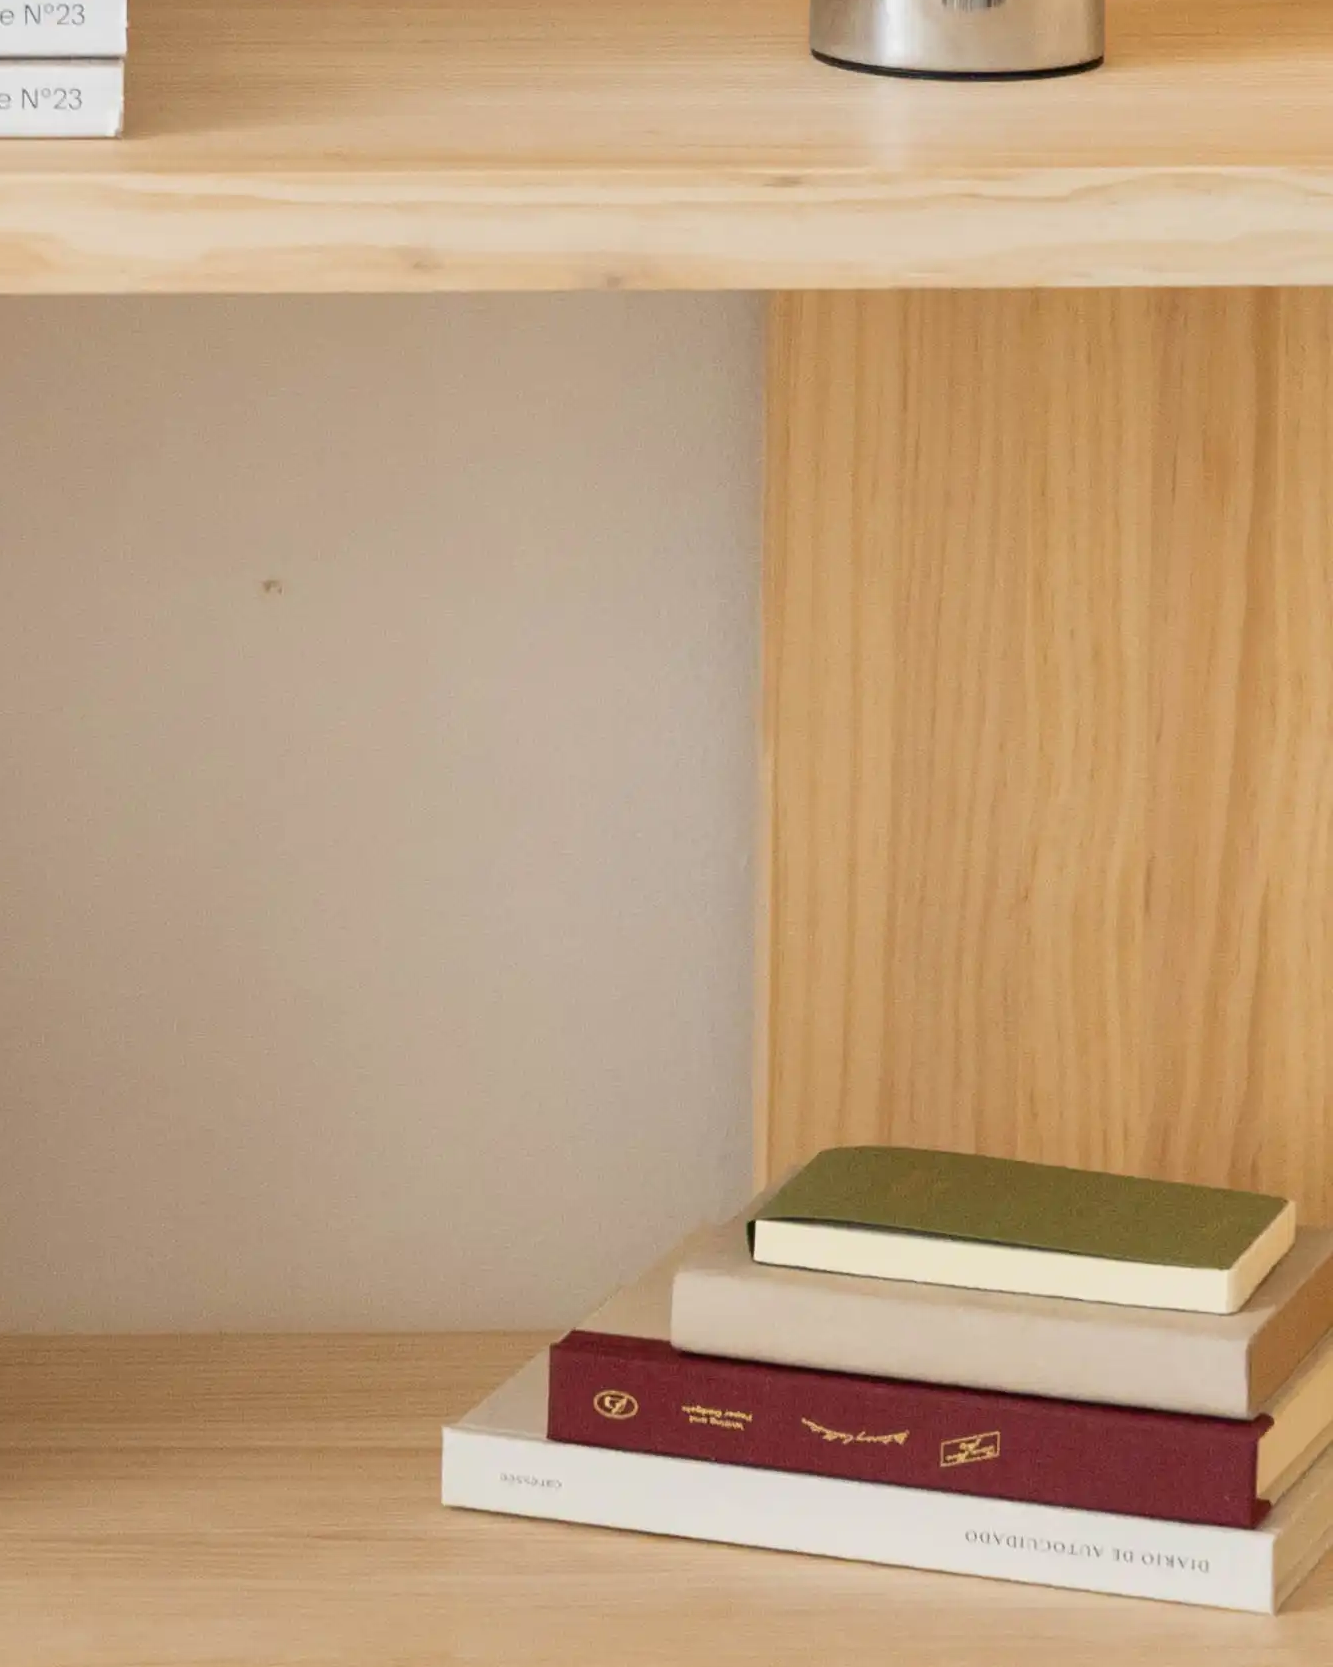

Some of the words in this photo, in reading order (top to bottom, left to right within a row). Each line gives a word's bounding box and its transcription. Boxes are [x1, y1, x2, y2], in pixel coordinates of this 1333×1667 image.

[24, 3, 86, 27] N°23
[21, 87, 83, 111] N°23
[965, 1530, 1103, 1558] AUTOCUIDADO
[1113, 1548, 1133, 1564] DE
[1141, 1549, 1210, 1574] DIARIO
